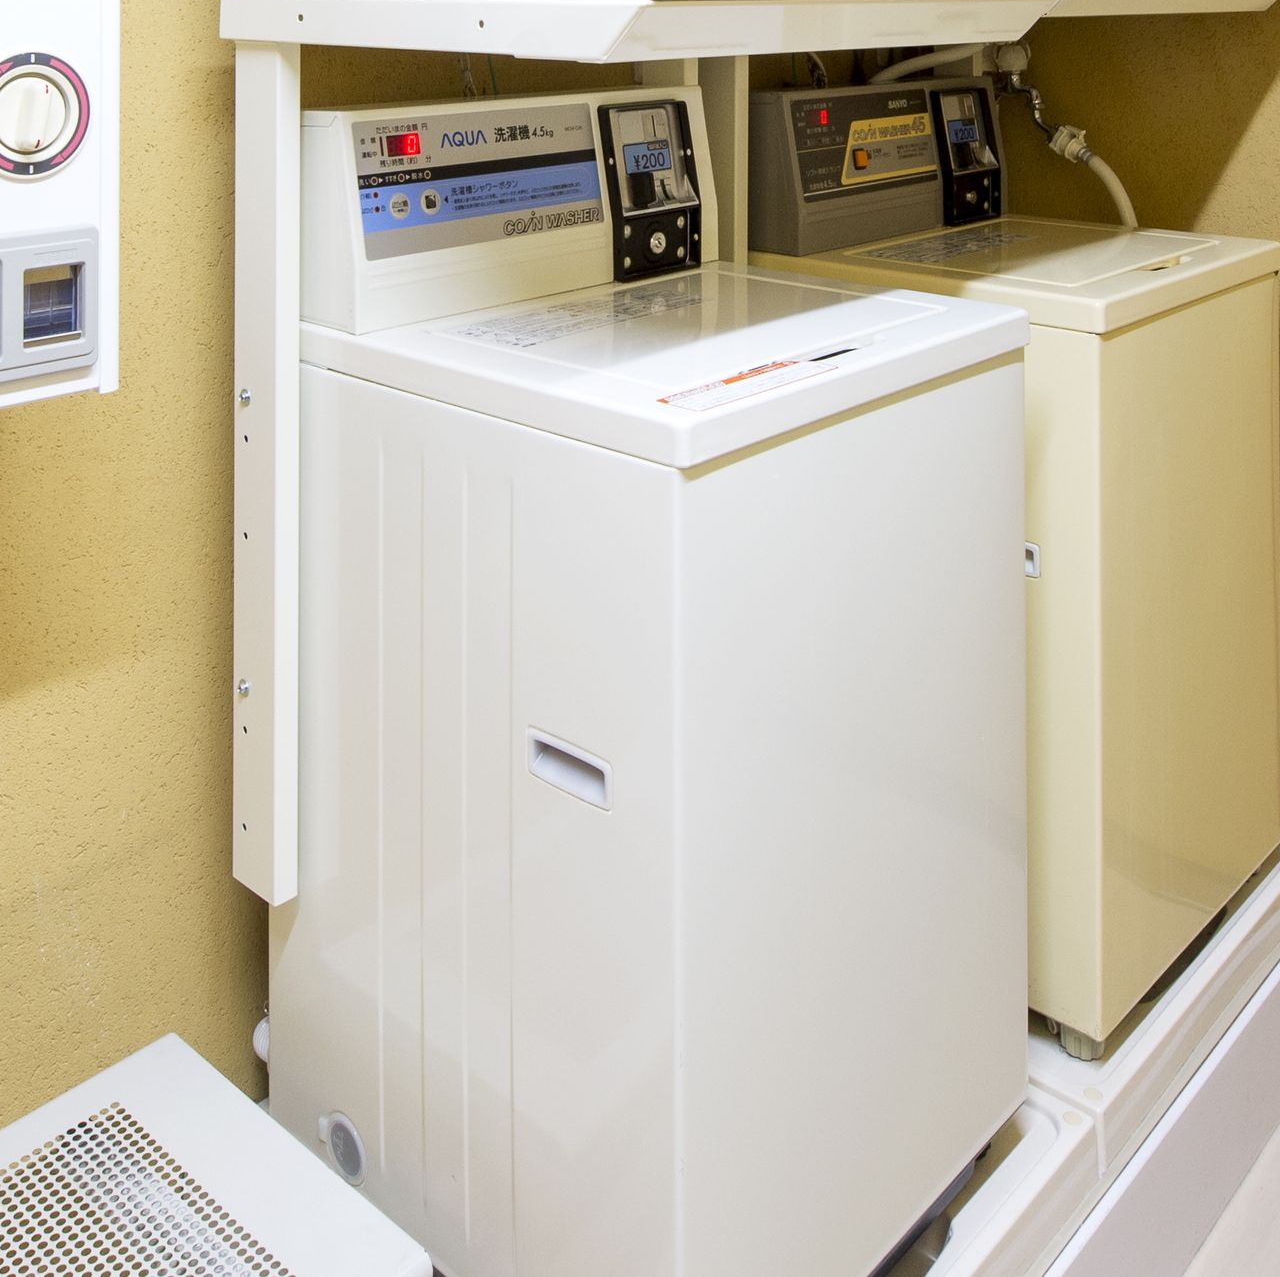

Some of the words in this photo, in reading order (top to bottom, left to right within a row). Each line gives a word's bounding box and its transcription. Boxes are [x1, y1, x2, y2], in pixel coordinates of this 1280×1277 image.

[887, 99, 908, 109] SANYO
[440, 129, 488, 148] AQUA
[493, 124, 531, 143] 洗濯機
[532, 125, 554, 138] 4.5kg
[407, 136, 417, 153] 0
[633, 152, 665, 171] ¥200
[546, 207, 600, 229] WASHER
